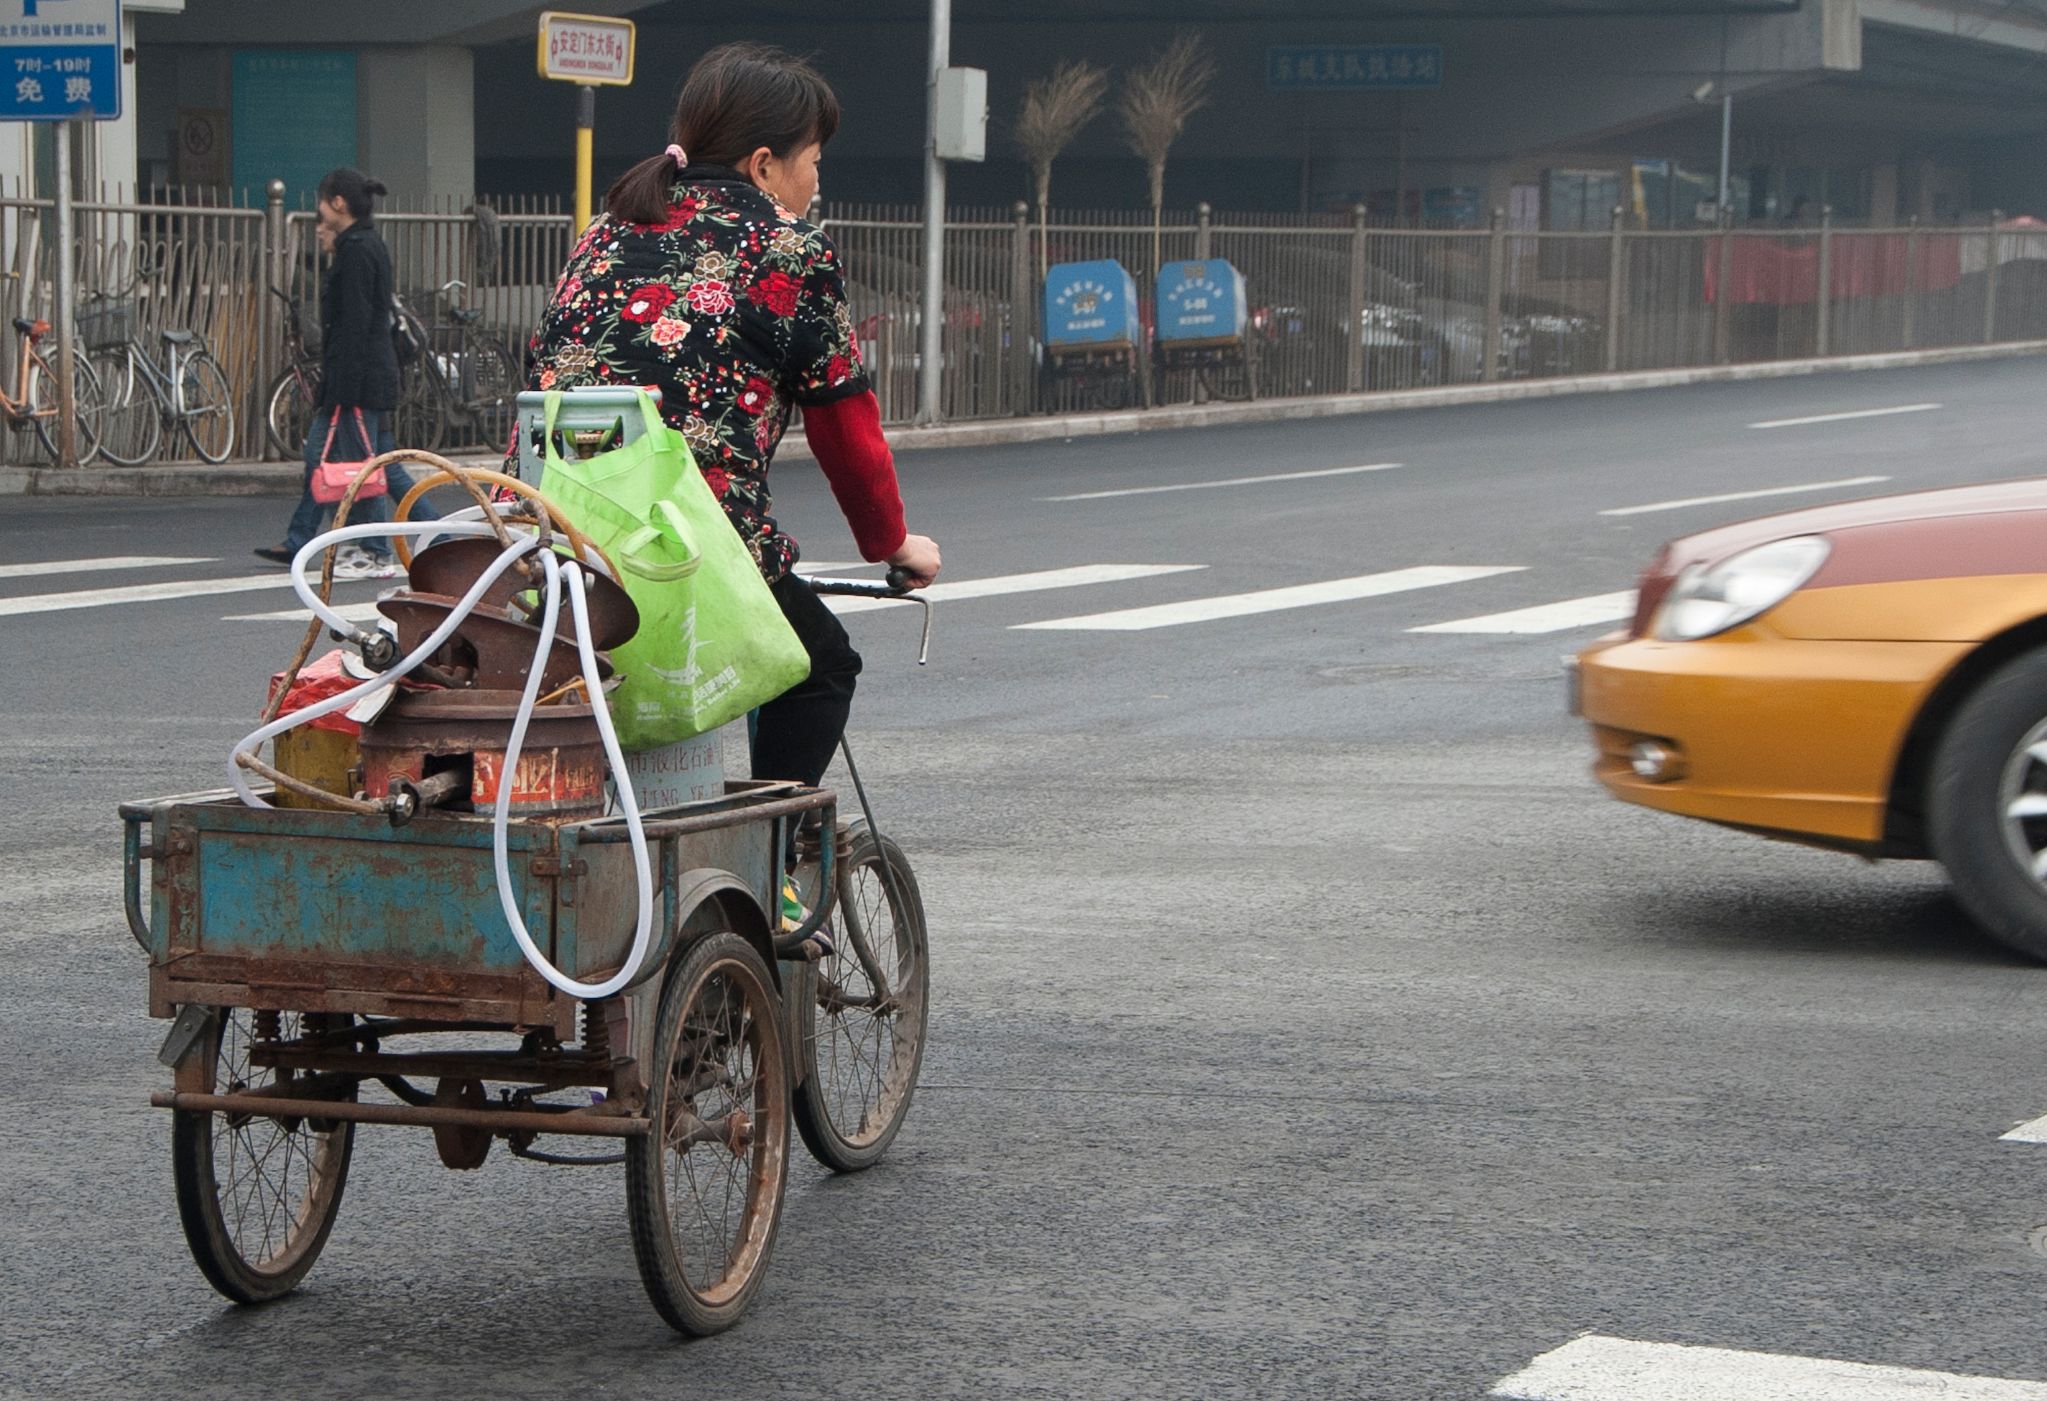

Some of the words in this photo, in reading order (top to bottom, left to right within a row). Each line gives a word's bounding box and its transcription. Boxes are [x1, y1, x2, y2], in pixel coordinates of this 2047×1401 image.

[560, 30, 615, 56] 安定门东大街
